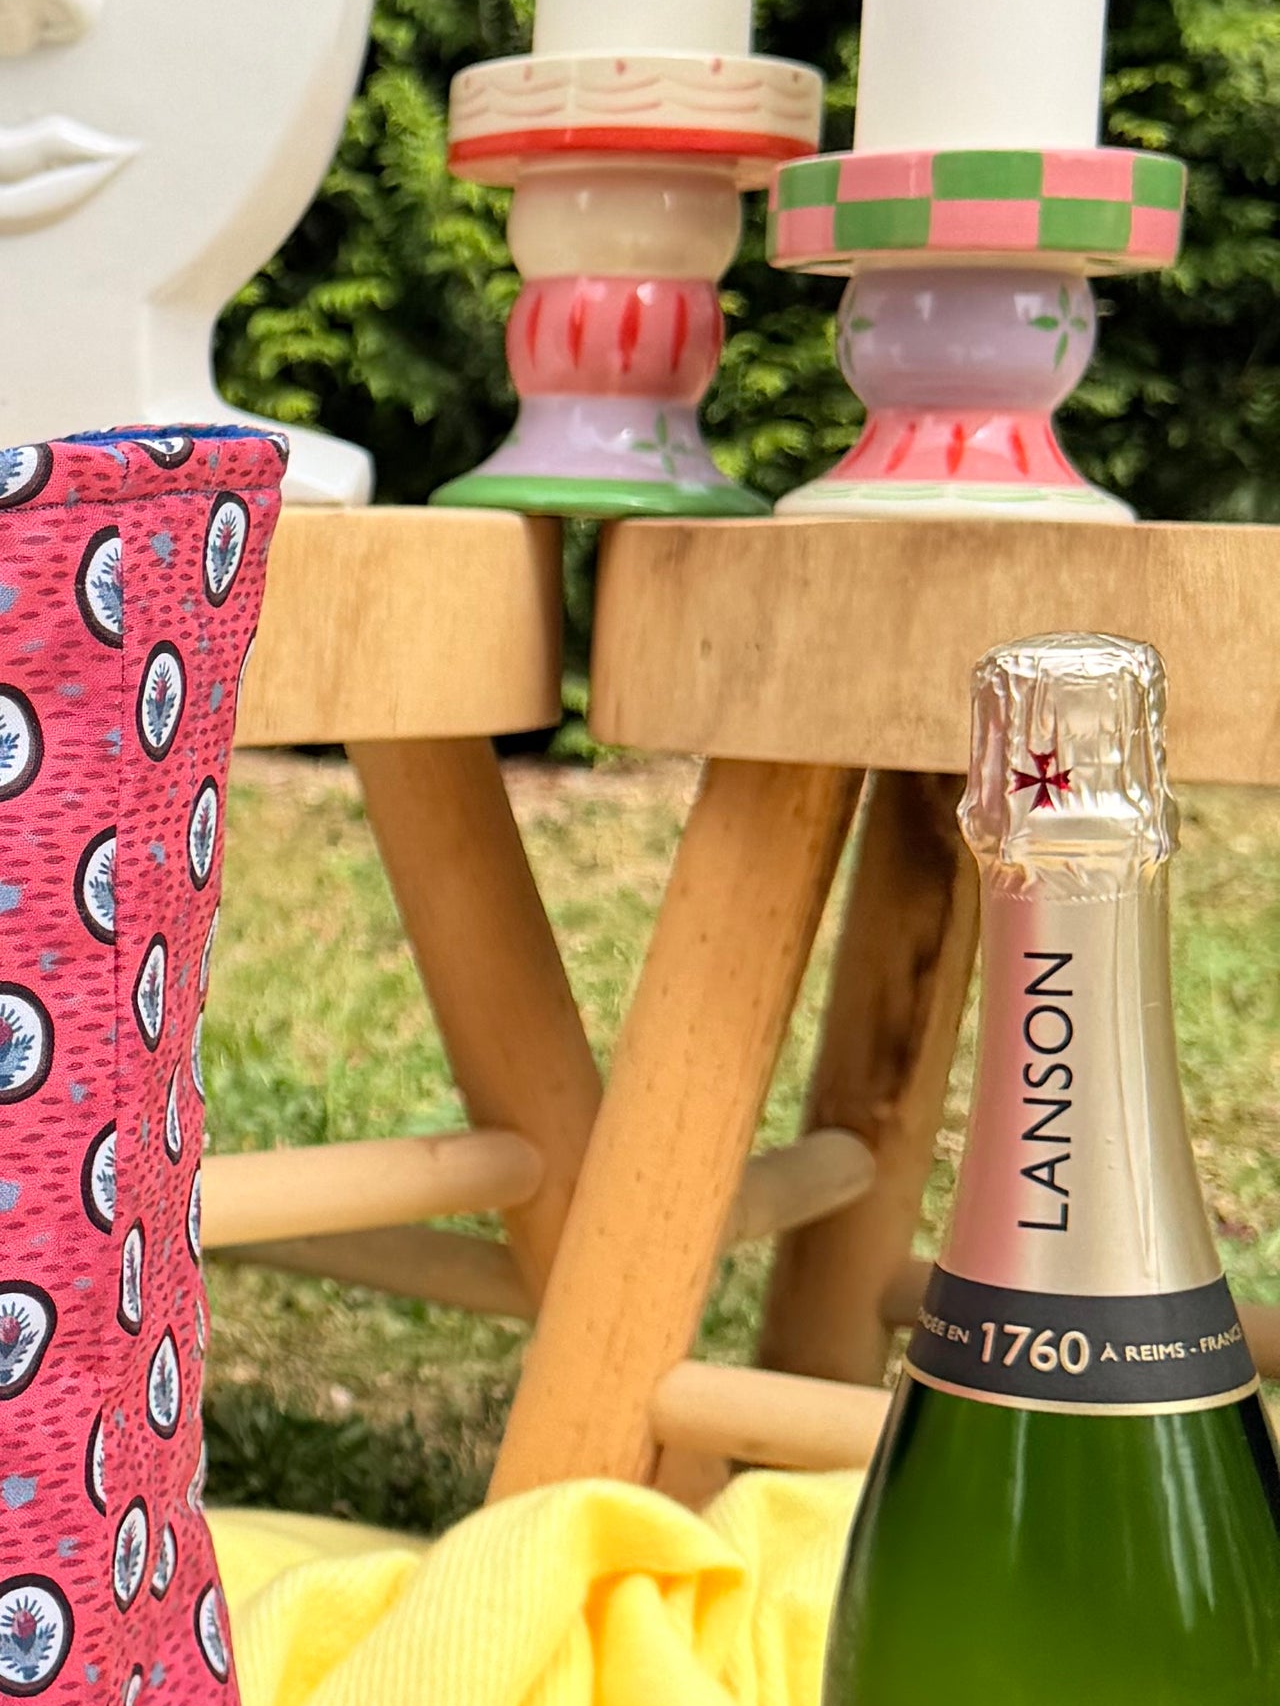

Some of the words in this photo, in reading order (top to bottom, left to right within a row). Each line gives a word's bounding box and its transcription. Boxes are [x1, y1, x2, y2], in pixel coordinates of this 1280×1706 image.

[1017, 952, 1073, 1232] LANSON
[947, 1324, 970, 1344] EN
[980, 1321, 1090, 1375] 1760
[1126, 1342, 1185, 1362] REIMS
[1199, 1323, 1242, 1353] FRANC
